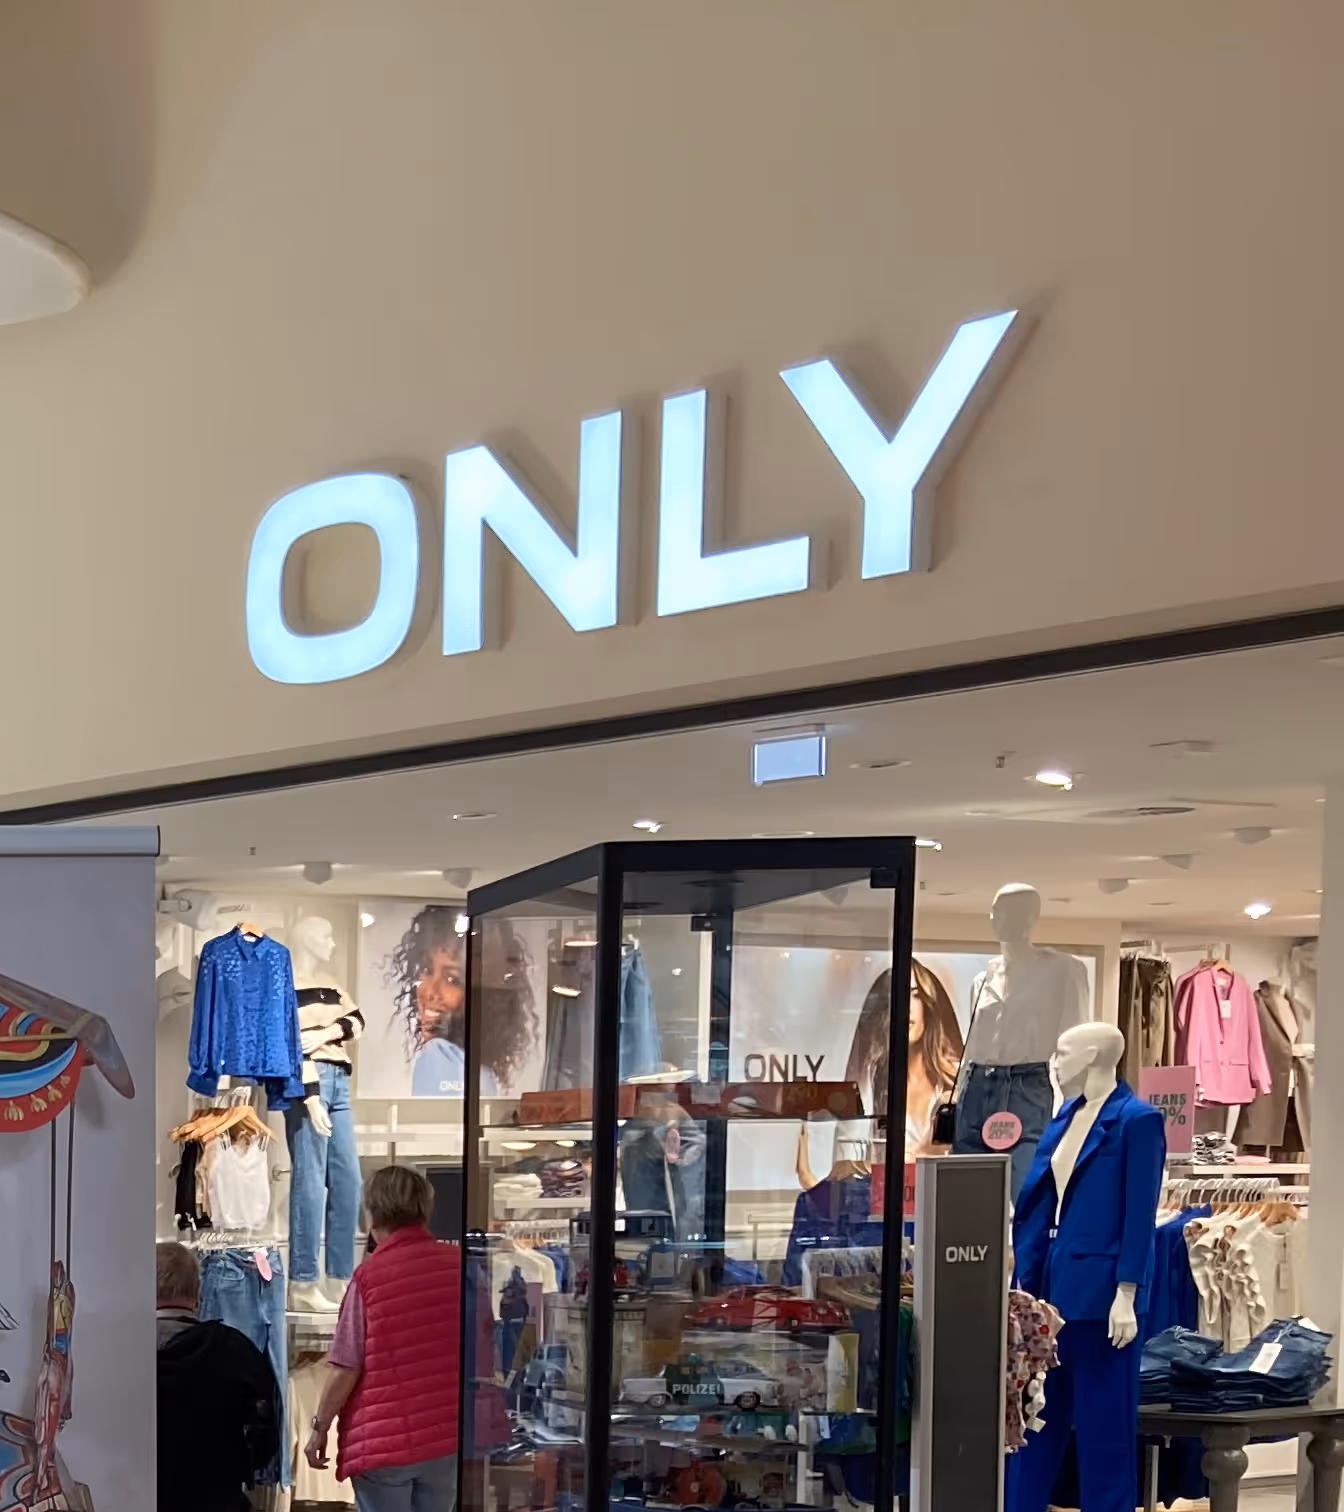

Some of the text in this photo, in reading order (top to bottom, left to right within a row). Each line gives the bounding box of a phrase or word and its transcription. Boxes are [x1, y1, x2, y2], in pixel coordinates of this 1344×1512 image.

[245, 309, 1018, 685] ONLY
[744, 1053, 826, 1083] ONLY
[1149, 1092, 1187, 1106] JEANS
[945, 1245, 988, 1263] ONLY
[672, 1382, 723, 1396] POLIZEI
